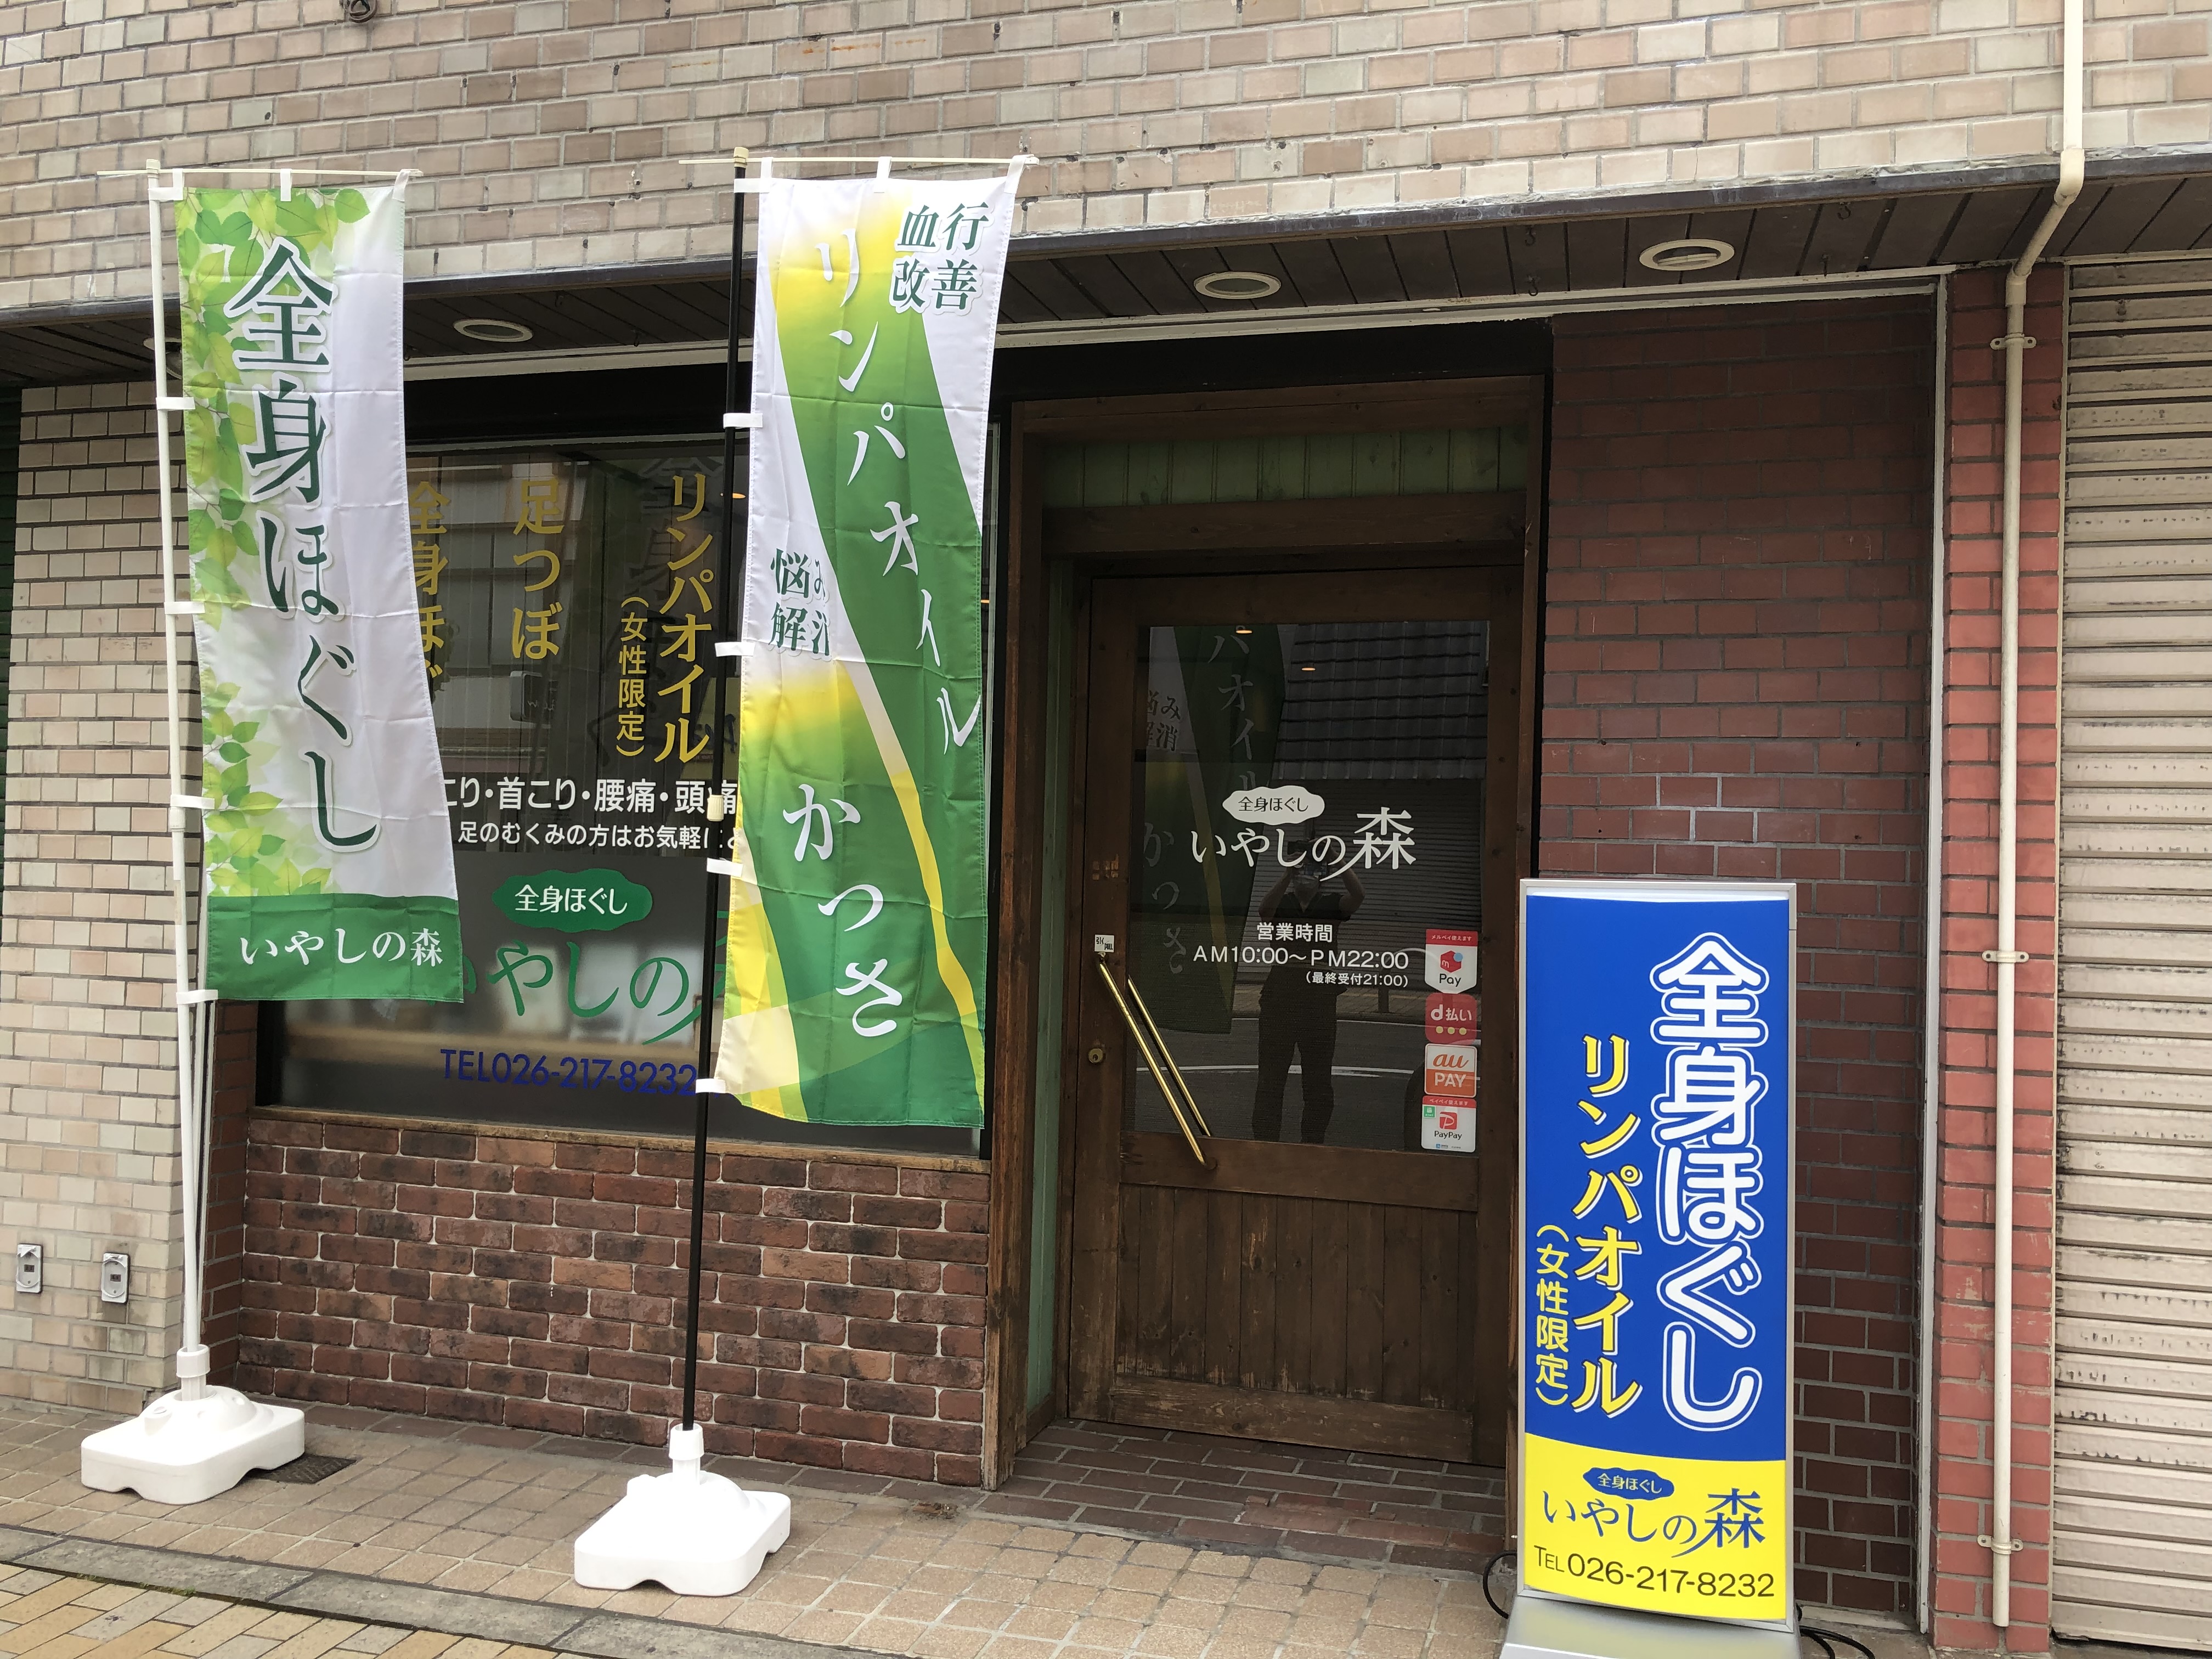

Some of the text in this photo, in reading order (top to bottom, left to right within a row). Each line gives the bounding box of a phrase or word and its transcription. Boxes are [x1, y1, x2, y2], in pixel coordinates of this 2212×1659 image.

[898, 201, 989, 251] 血行
[892, 258, 978, 311] 改善
[815, 228, 981, 755] リンパオイル
[224, 238, 380, 851] 全身ほぐし
[511, 478, 565, 660] 足つぼ
[653, 473, 714, 763] リンパオイル
[616, 596, 650, 758] （女性限定）
[1238, 796, 1309, 812] 全身ほぐし
[1190, 806, 1417, 882] いやしの森
[514, 884, 628, 915] 全身ほぐし
[240, 928, 443, 968] いやしの森
[1256, 922, 1333, 943] 営業時間
[464, 911, 730, 1046] やしの
[1306, 971, 1409, 988] （最終受付21:00）
[1439, 973, 1462, 988] Pay
[1430, 1004, 1472, 1022] d払い
[1432, 1053, 1469, 1069] au
[1434, 1071, 1466, 1088] PAY
[1434, 1130, 1463, 1141] PayPay
[1650, 932, 1770, 1432] 全身ほぐし
[1571, 1033, 1643, 1418] リンパオイル
[1535, 1224, 1569, 1406] （女性限定）
[1597, 1472, 1662, 1494] 全身ほぐし
[1542, 1487, 1766, 1559] いやしの森
